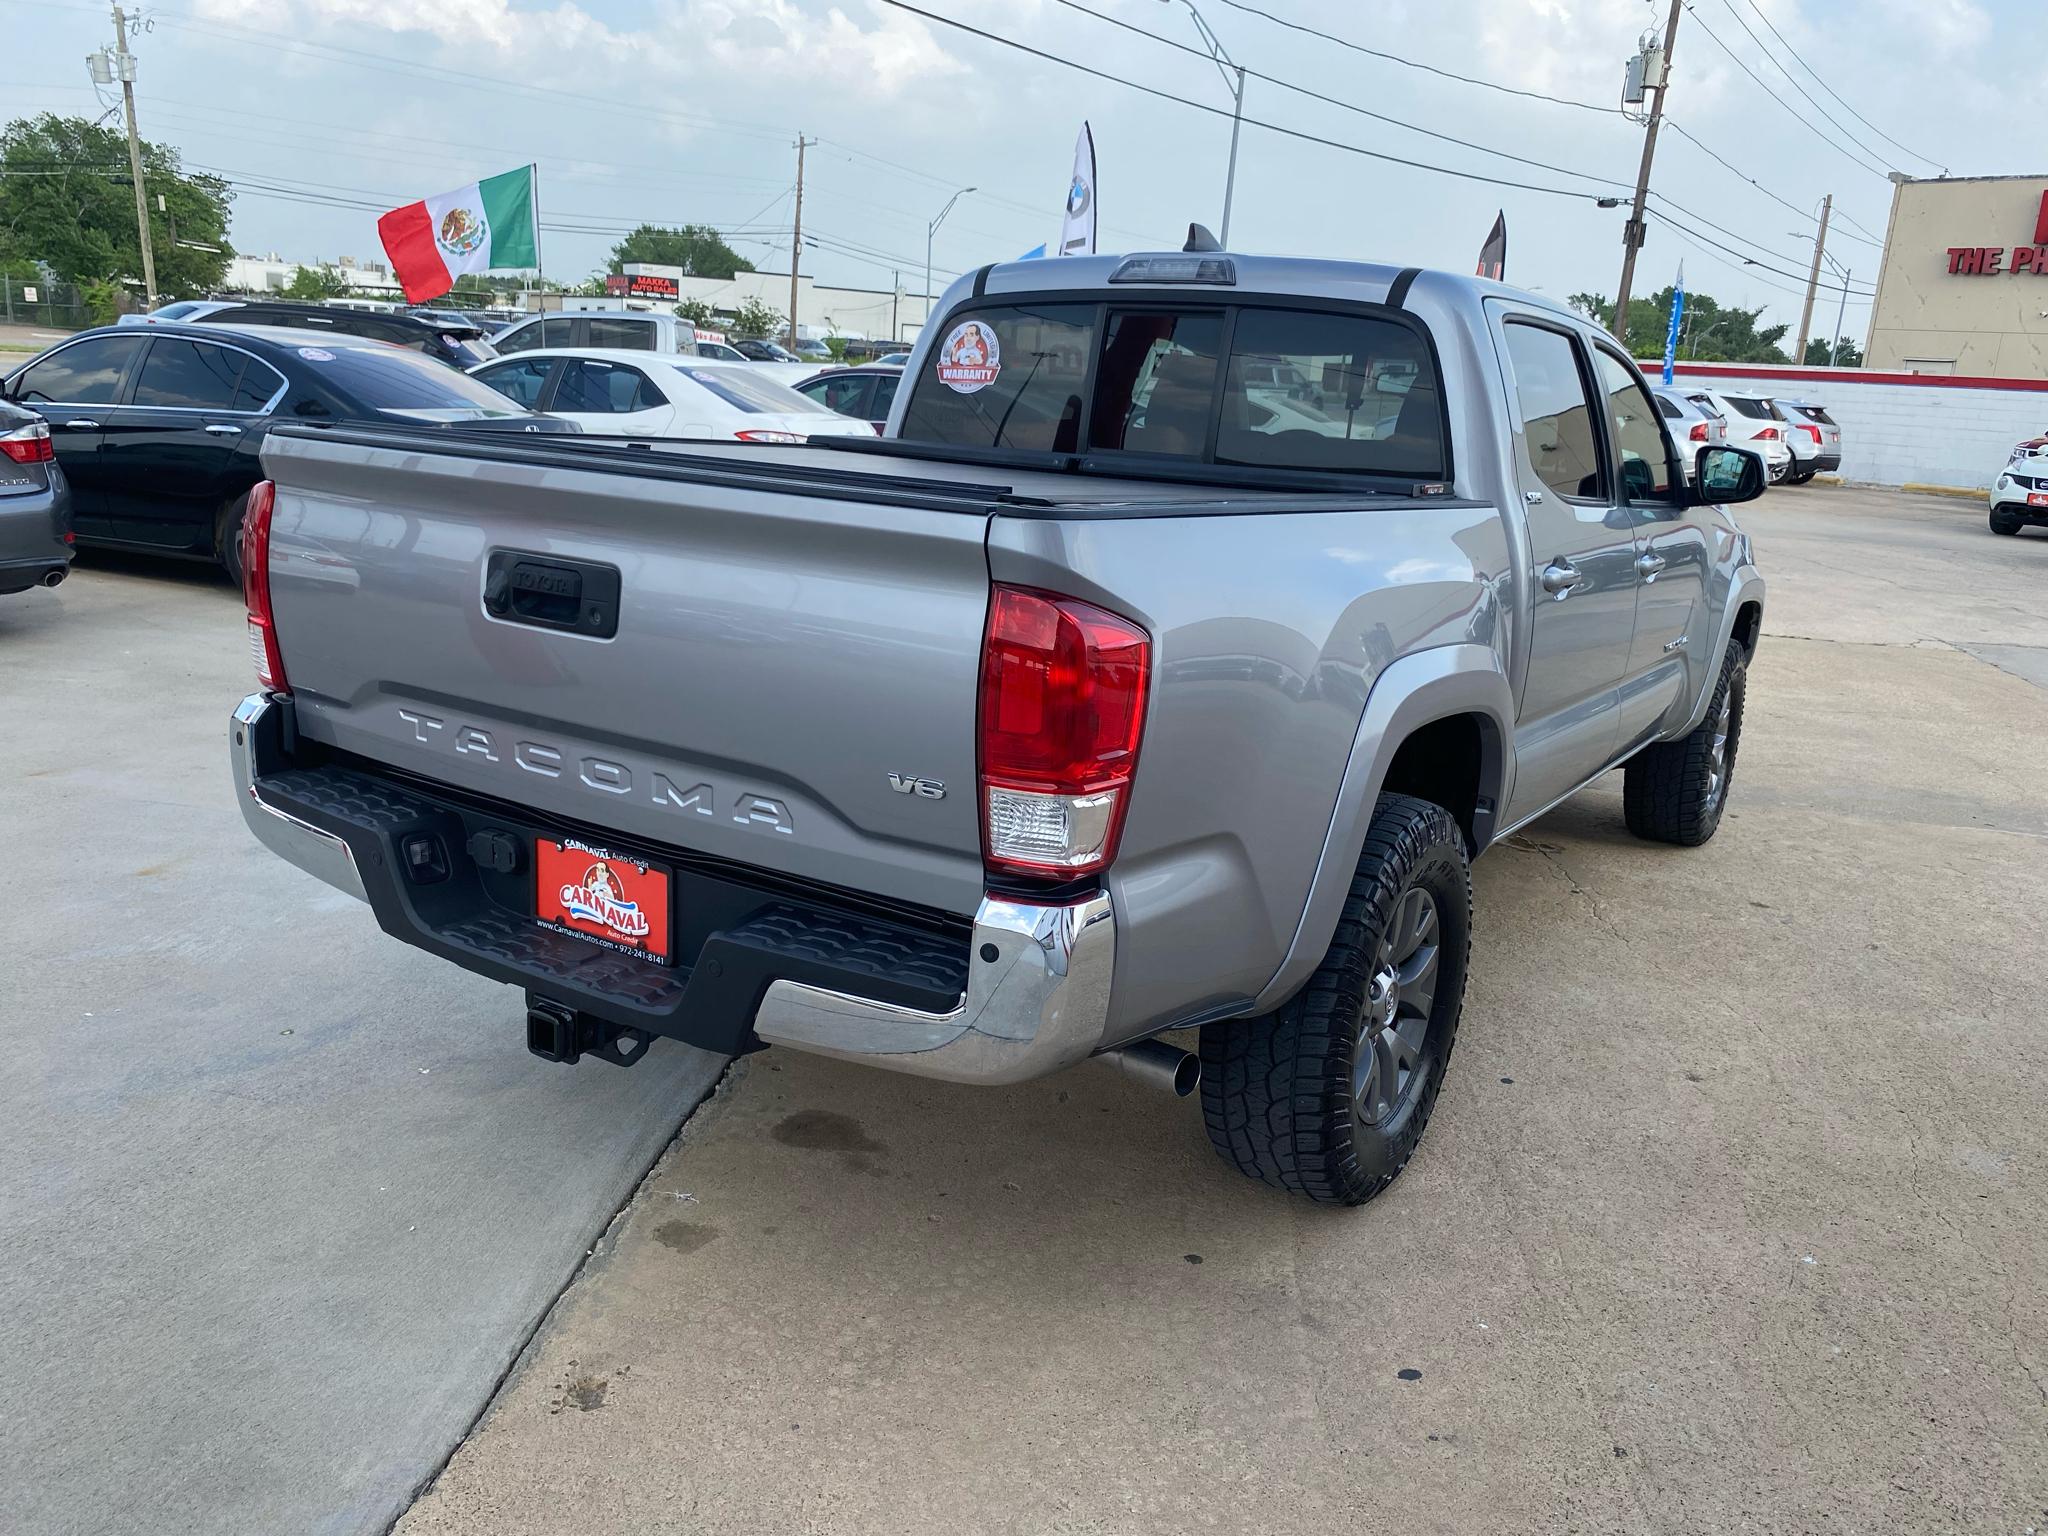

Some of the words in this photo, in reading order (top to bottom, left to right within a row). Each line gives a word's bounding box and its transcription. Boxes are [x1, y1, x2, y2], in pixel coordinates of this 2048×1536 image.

[1946, 247, 2003, 275] THE
[637, 276, 670, 286] MAKKA
[950, 330, 962, 343] FREE
[943, 369, 993, 380] WARRANTY
[515, 569, 571, 593] TOYOTA
[398, 707, 794, 834] TACOMA
[887, 770, 948, 802] V6
[564, 838, 611, 860] CARNAVAL
[611, 852, 628, 863] Auto
[629, 856, 649, 869] Credit
[561, 886, 648, 932] CARNAVAL
[537, 920, 614, 950] www.CarnavalAutos.com
[619, 945, 664, 965] 972-241-8141
[607, 929, 621, 939] Auto
[621, 933, 639, 944] Credit
